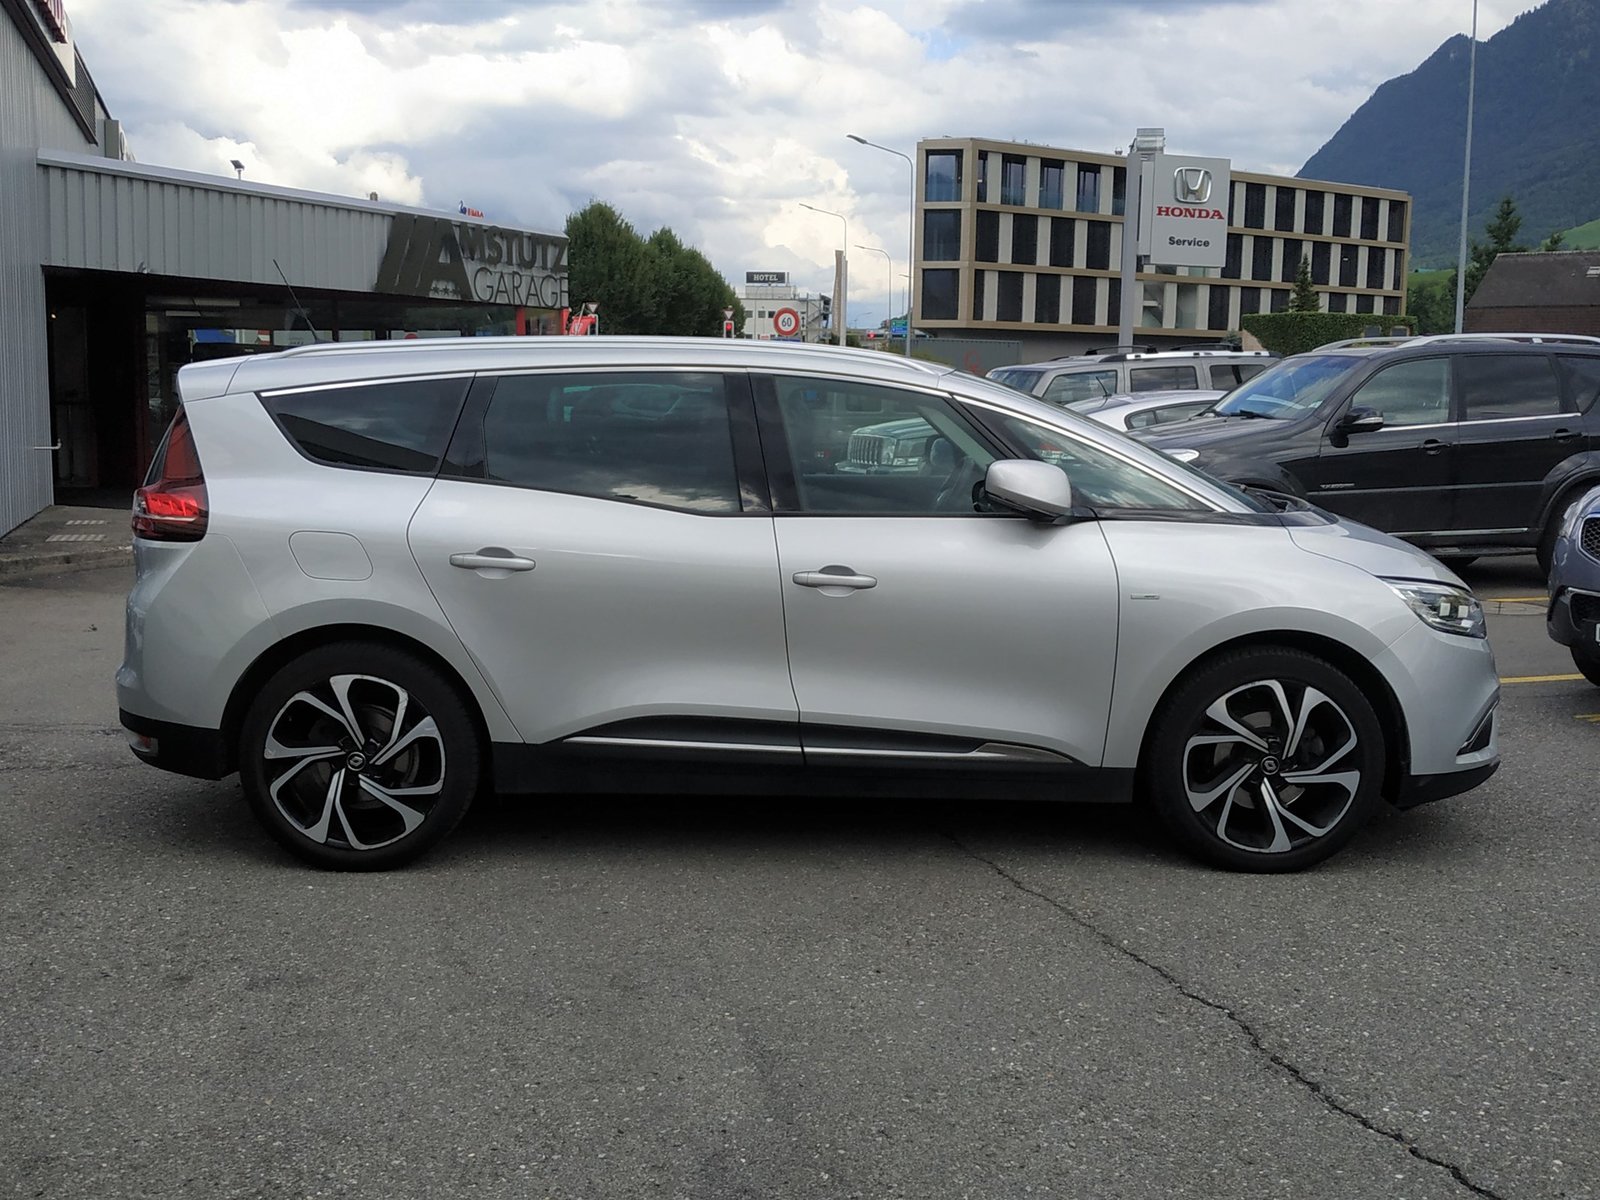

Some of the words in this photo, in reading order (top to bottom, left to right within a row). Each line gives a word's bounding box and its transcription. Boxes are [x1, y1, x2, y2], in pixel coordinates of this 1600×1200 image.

[1156, 206, 1225, 220] HONDA
[1168, 236, 1210, 247] Service
[414, 217, 568, 301] AMSTUTZ
[753, 274, 778, 282] HOTEL
[473, 267, 568, 309] GARAGE
[782, 317, 792, 327] 60
